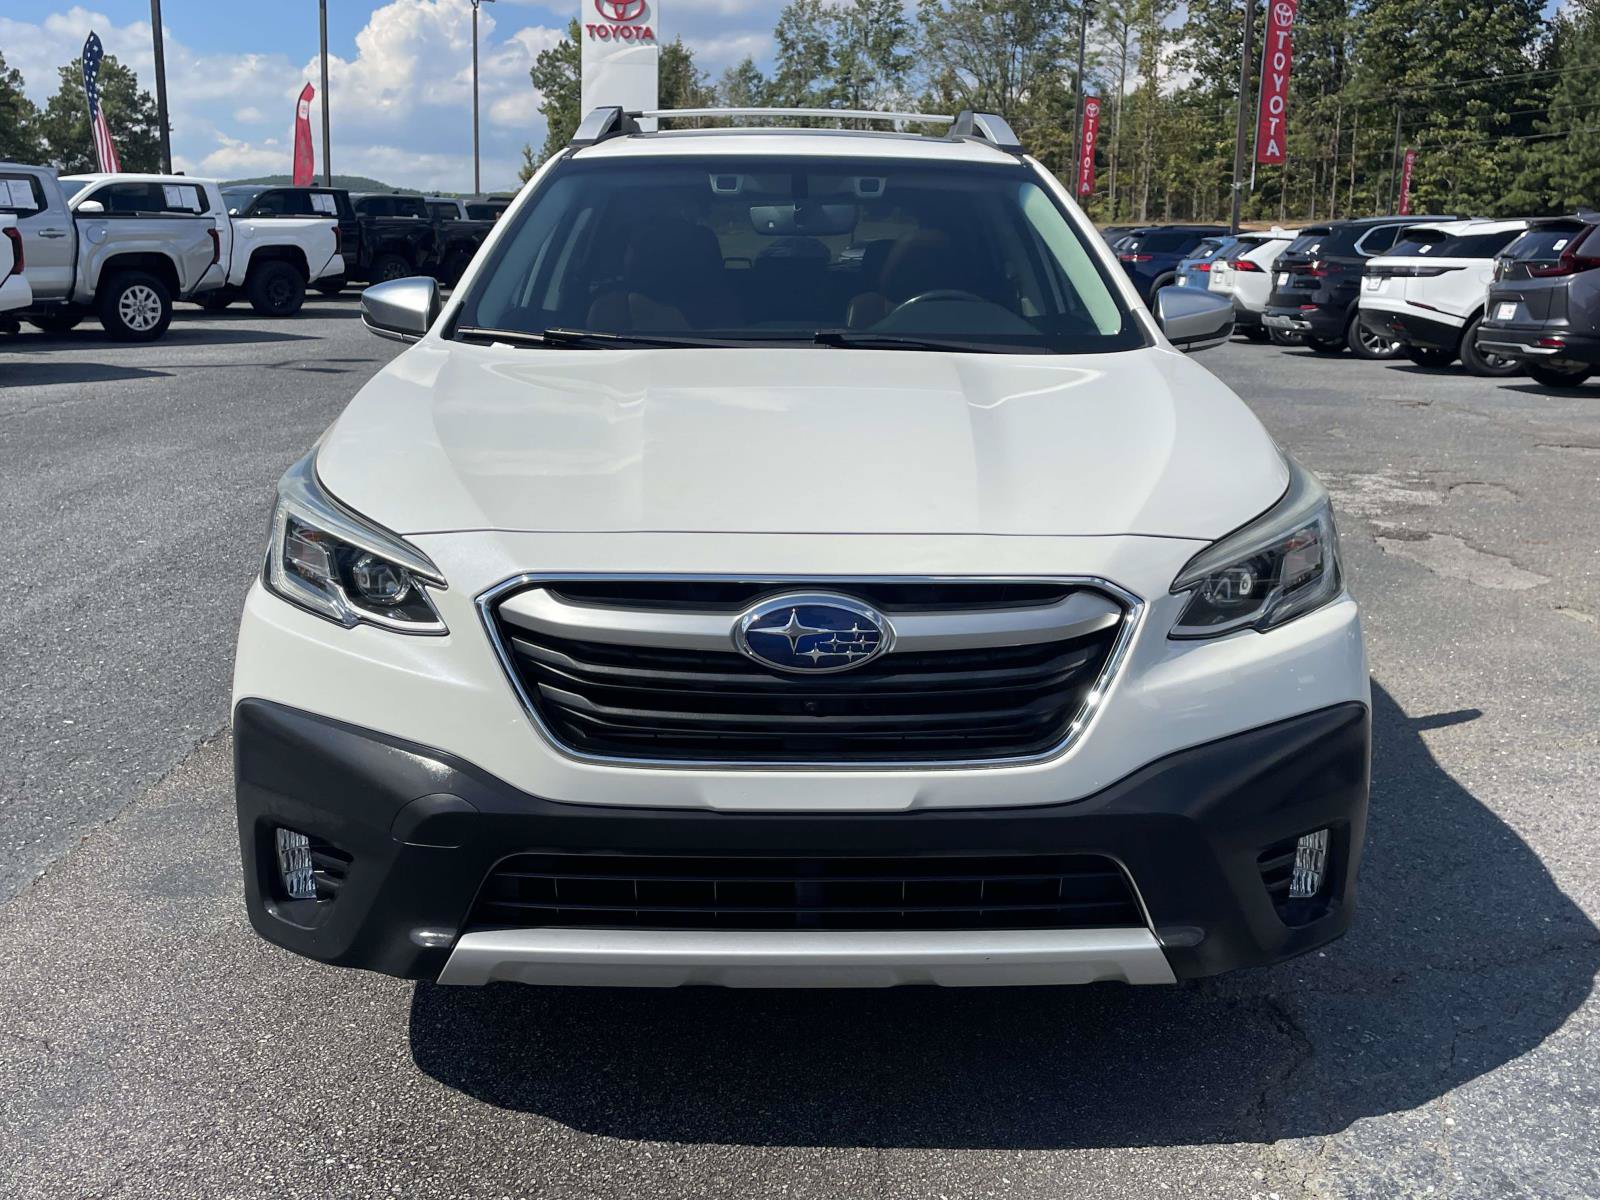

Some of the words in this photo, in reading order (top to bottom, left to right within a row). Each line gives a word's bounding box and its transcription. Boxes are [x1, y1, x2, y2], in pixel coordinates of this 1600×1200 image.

[586, 24, 656, 40] TOYOTA
[1266, 31, 1288, 156] TOYOTA
[1082, 119, 1095, 193] TOYOTA
